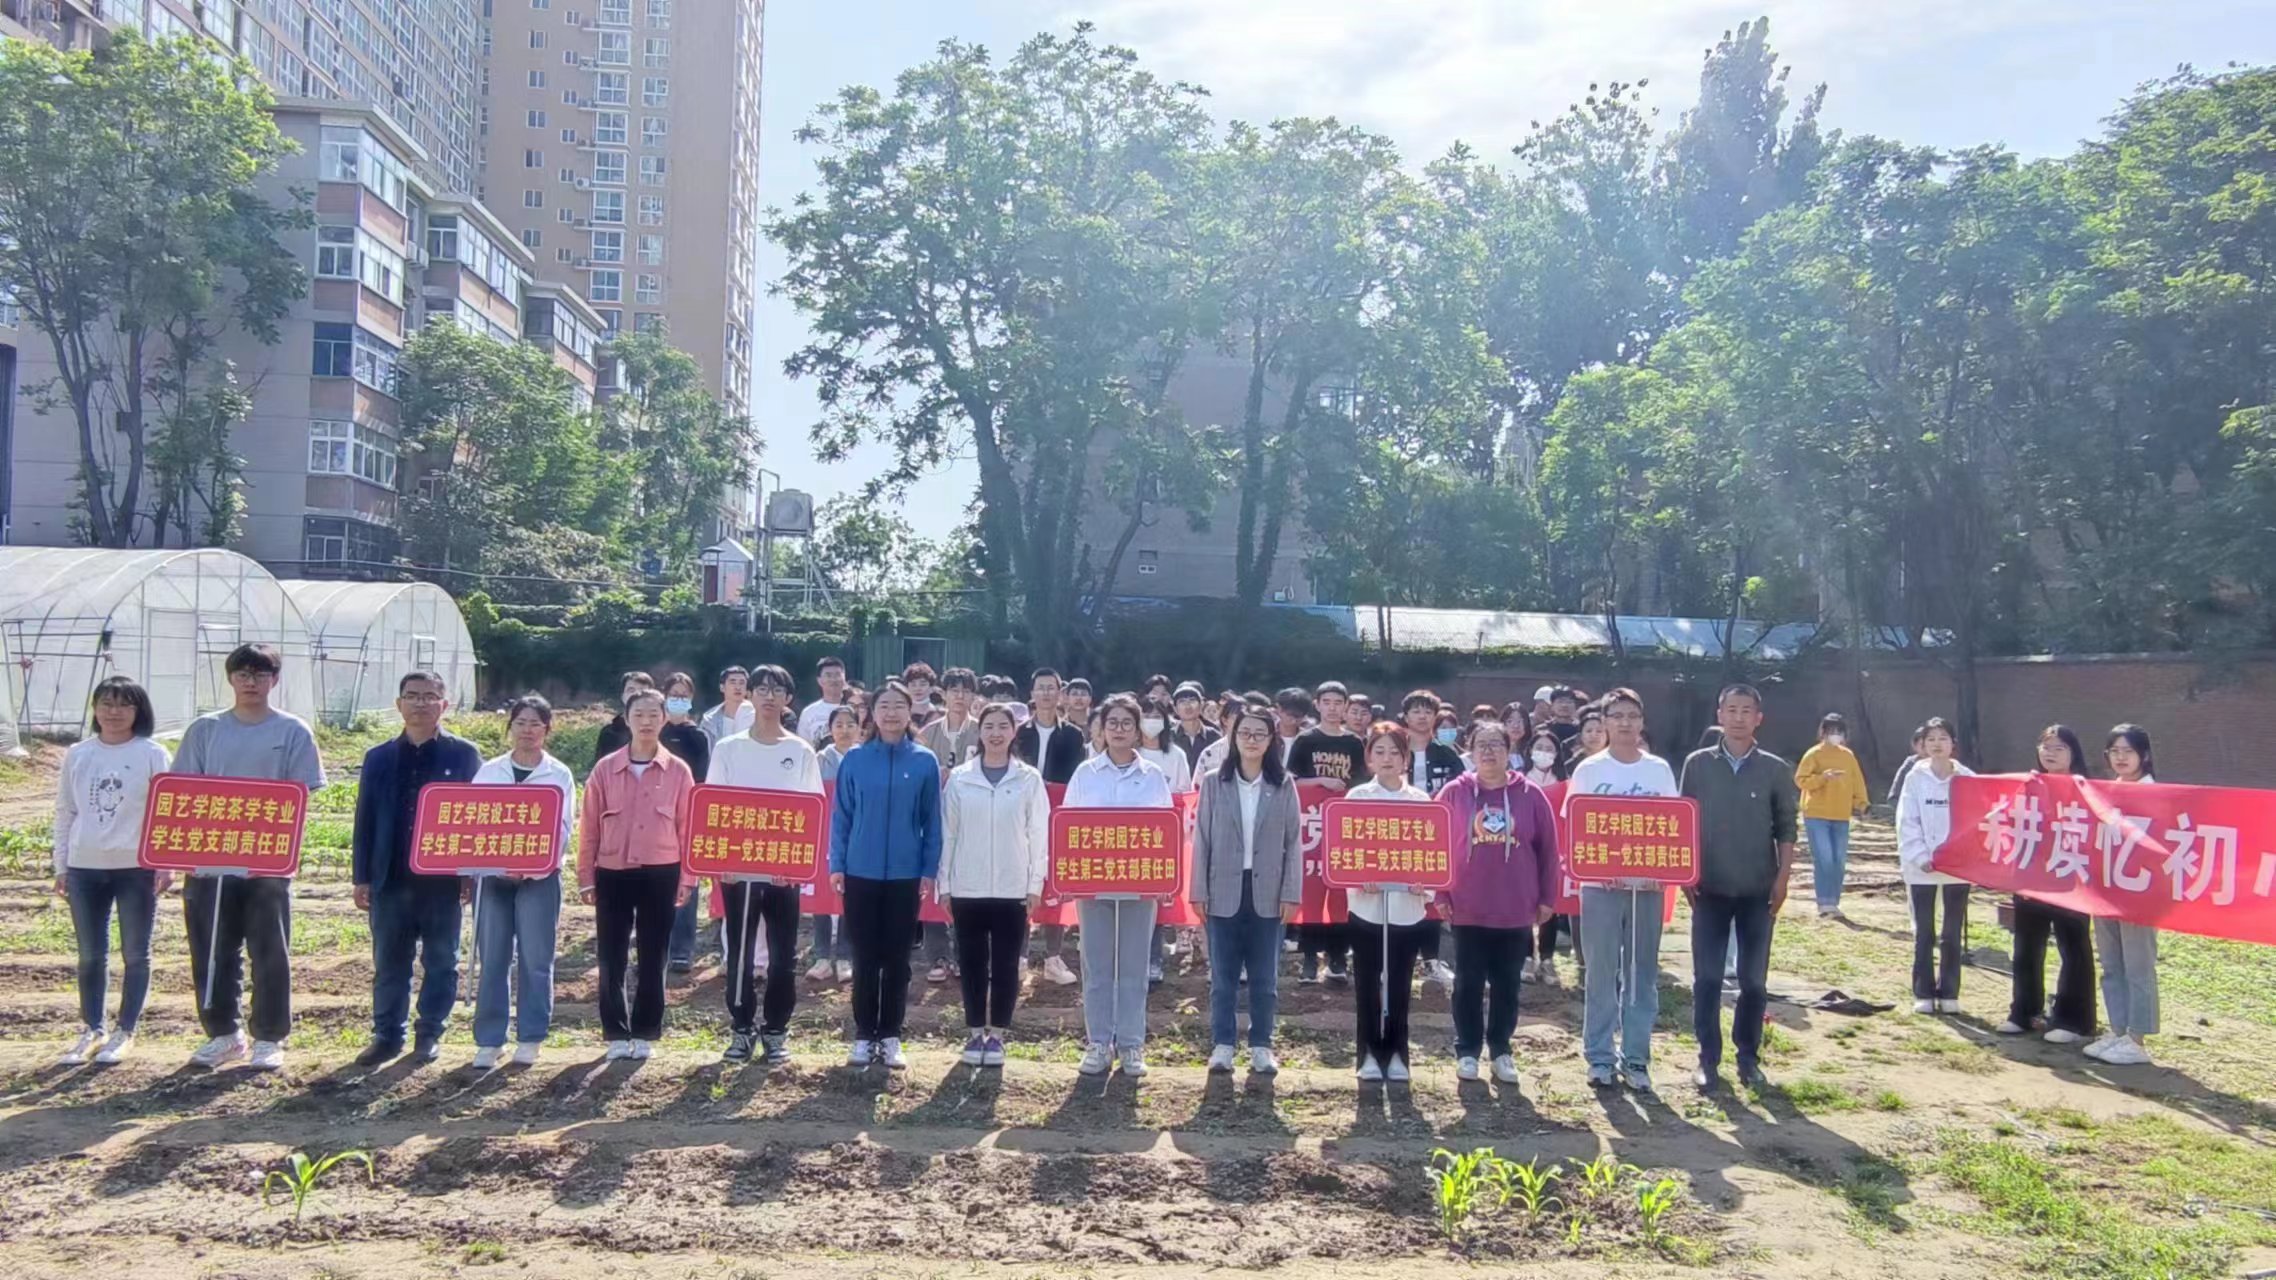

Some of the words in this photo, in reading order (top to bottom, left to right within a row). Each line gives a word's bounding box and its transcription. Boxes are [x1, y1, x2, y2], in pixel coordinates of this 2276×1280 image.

[156, 792, 295, 824] 园艺学院茶学专业
[437, 802, 542, 825] 园艺学院设工专业
[707, 803, 806, 833] 园艺学院设工专业
[1342, 816, 1435, 841] 园艺学院园艺专业
[1585, 812, 1680, 837] 园艺学院园艺专业
[150, 825, 290, 855] 学生党支部责任田
[420, 833, 551, 856] 学生第二党支部责任田
[692, 835, 815, 865] 学生第一党支部责任田
[1068, 826, 1164, 849] 园艺学院园艺专业
[1330, 847, 1447, 872] 学生第二党支部责任田
[1574, 841, 1691, 867] 学生第一党支部责任田
[1056, 857, 1175, 881] 学生第三党支部责任田
